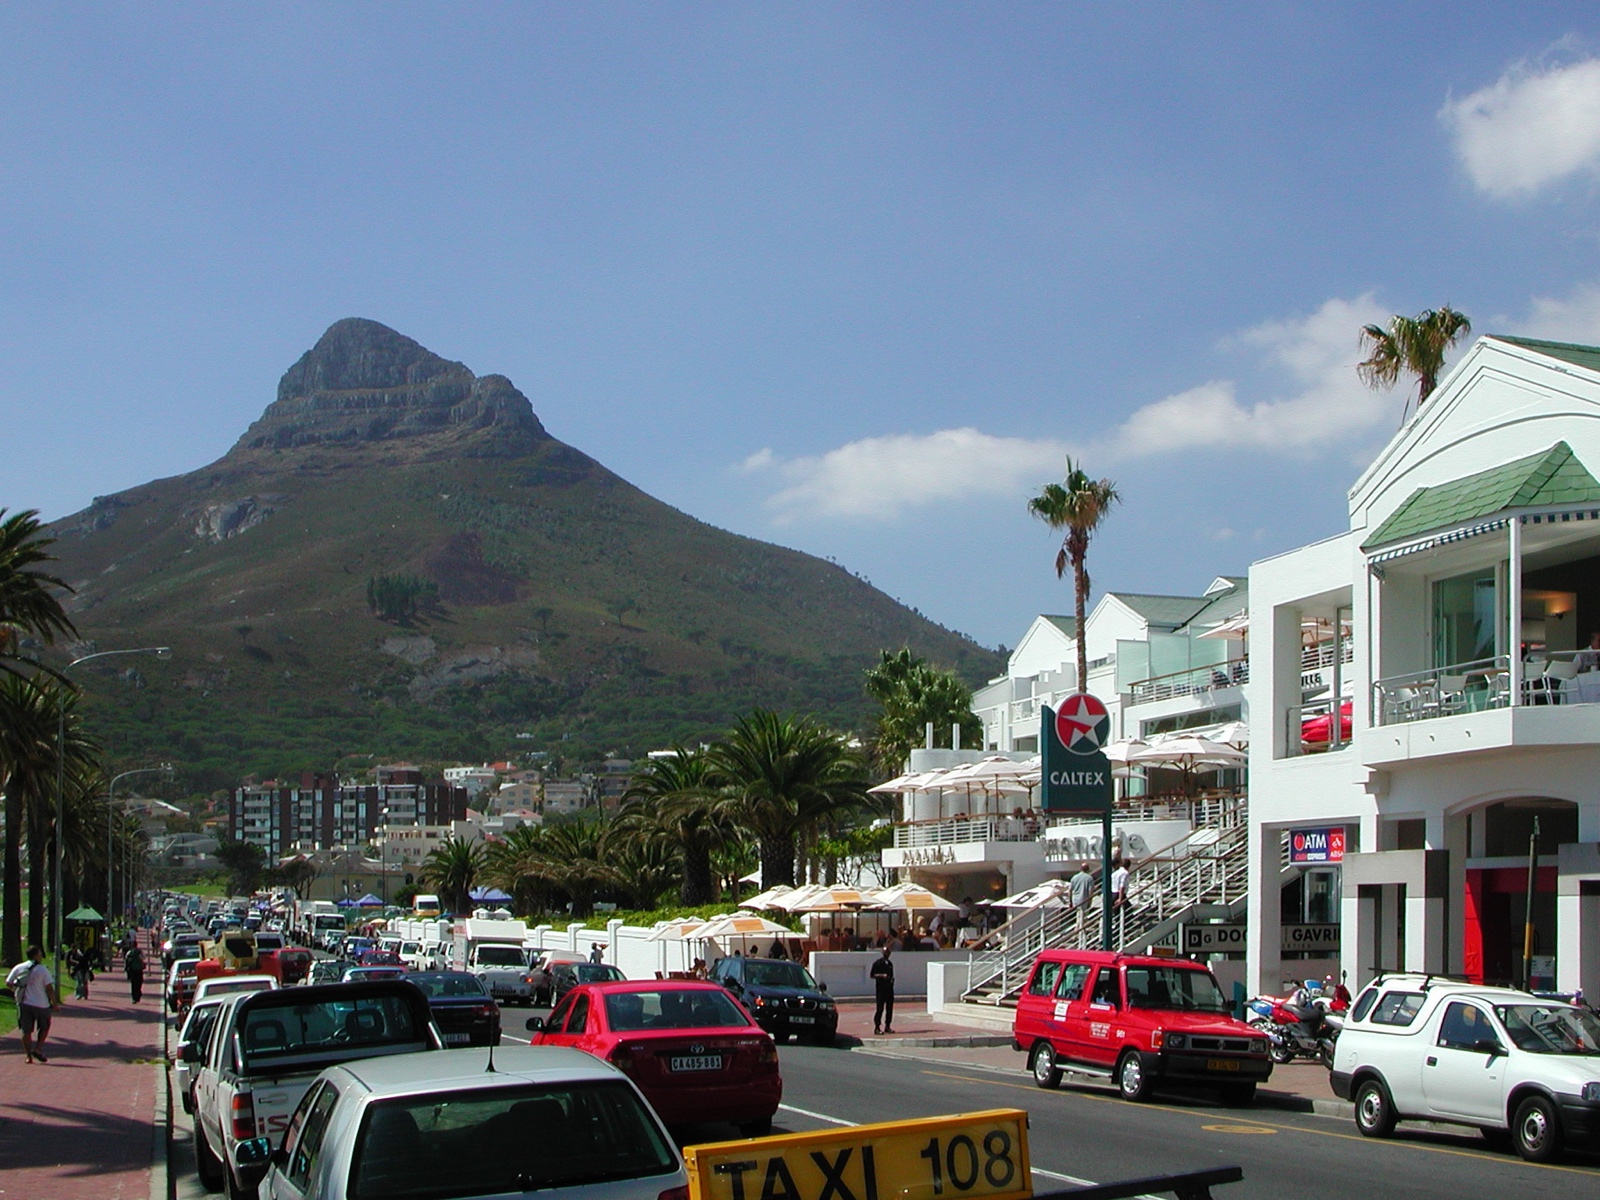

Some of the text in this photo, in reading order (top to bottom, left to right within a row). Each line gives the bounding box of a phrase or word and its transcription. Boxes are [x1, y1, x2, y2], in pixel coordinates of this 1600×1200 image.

[1050, 771, 1104, 786] CALTEX
[1304, 834, 1326, 849] ATM
[673, 1058, 684, 1069] CA
[714, 1129, 1015, 1200] TAXI 108
